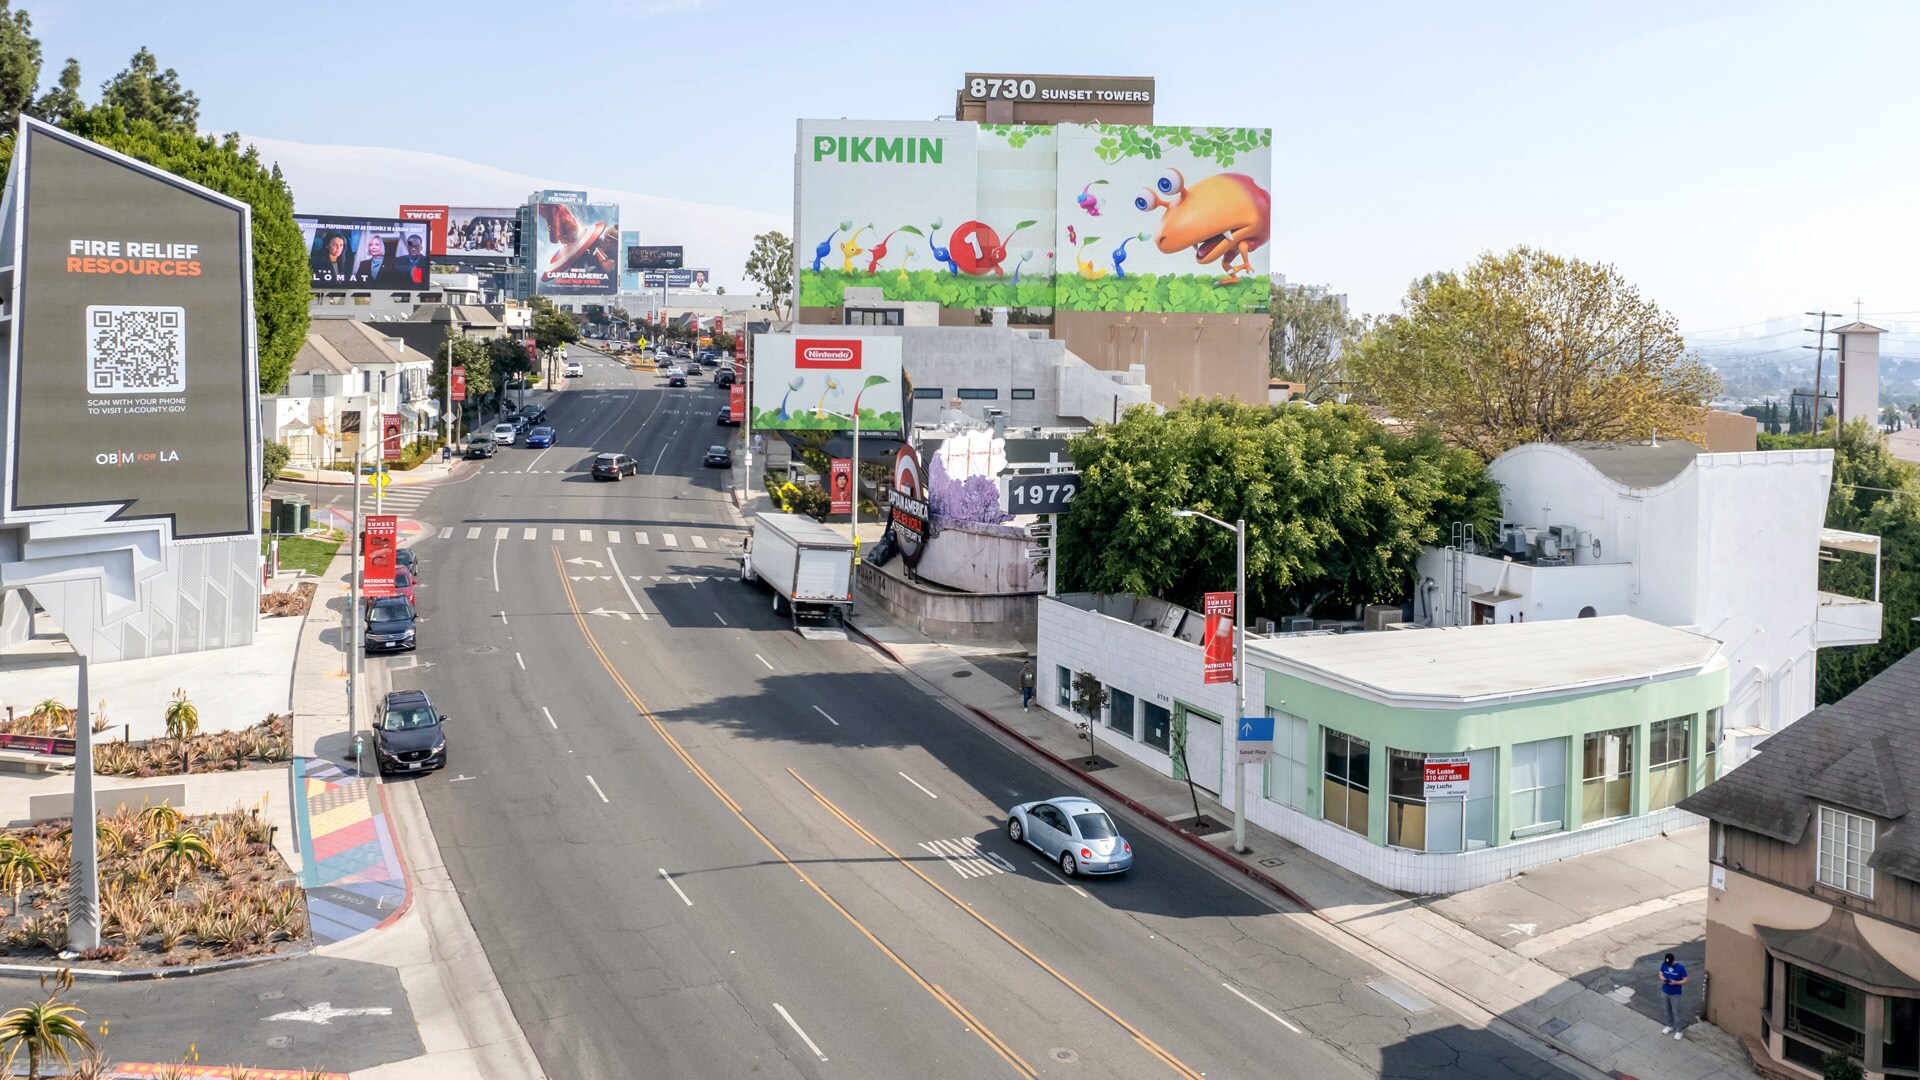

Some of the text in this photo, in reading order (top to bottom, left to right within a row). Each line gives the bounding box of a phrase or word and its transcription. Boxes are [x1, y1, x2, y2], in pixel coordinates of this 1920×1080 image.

[970, 78, 1150, 101] 8730 SUNSET TOWERS
[813, 136, 943, 164] PIKMIN
[70, 239, 198, 259] FIRE RELIEF
[66, 257, 202, 276] RESOURCES
[313, 273, 368, 282] LOMAT
[808, 350, 849, 358] Nintendo
[137, 453, 156, 461] FOR
[160, 450, 179, 462] LA
[1014, 484, 1076, 505] 1972
[917, 836, 1017, 879] XING
